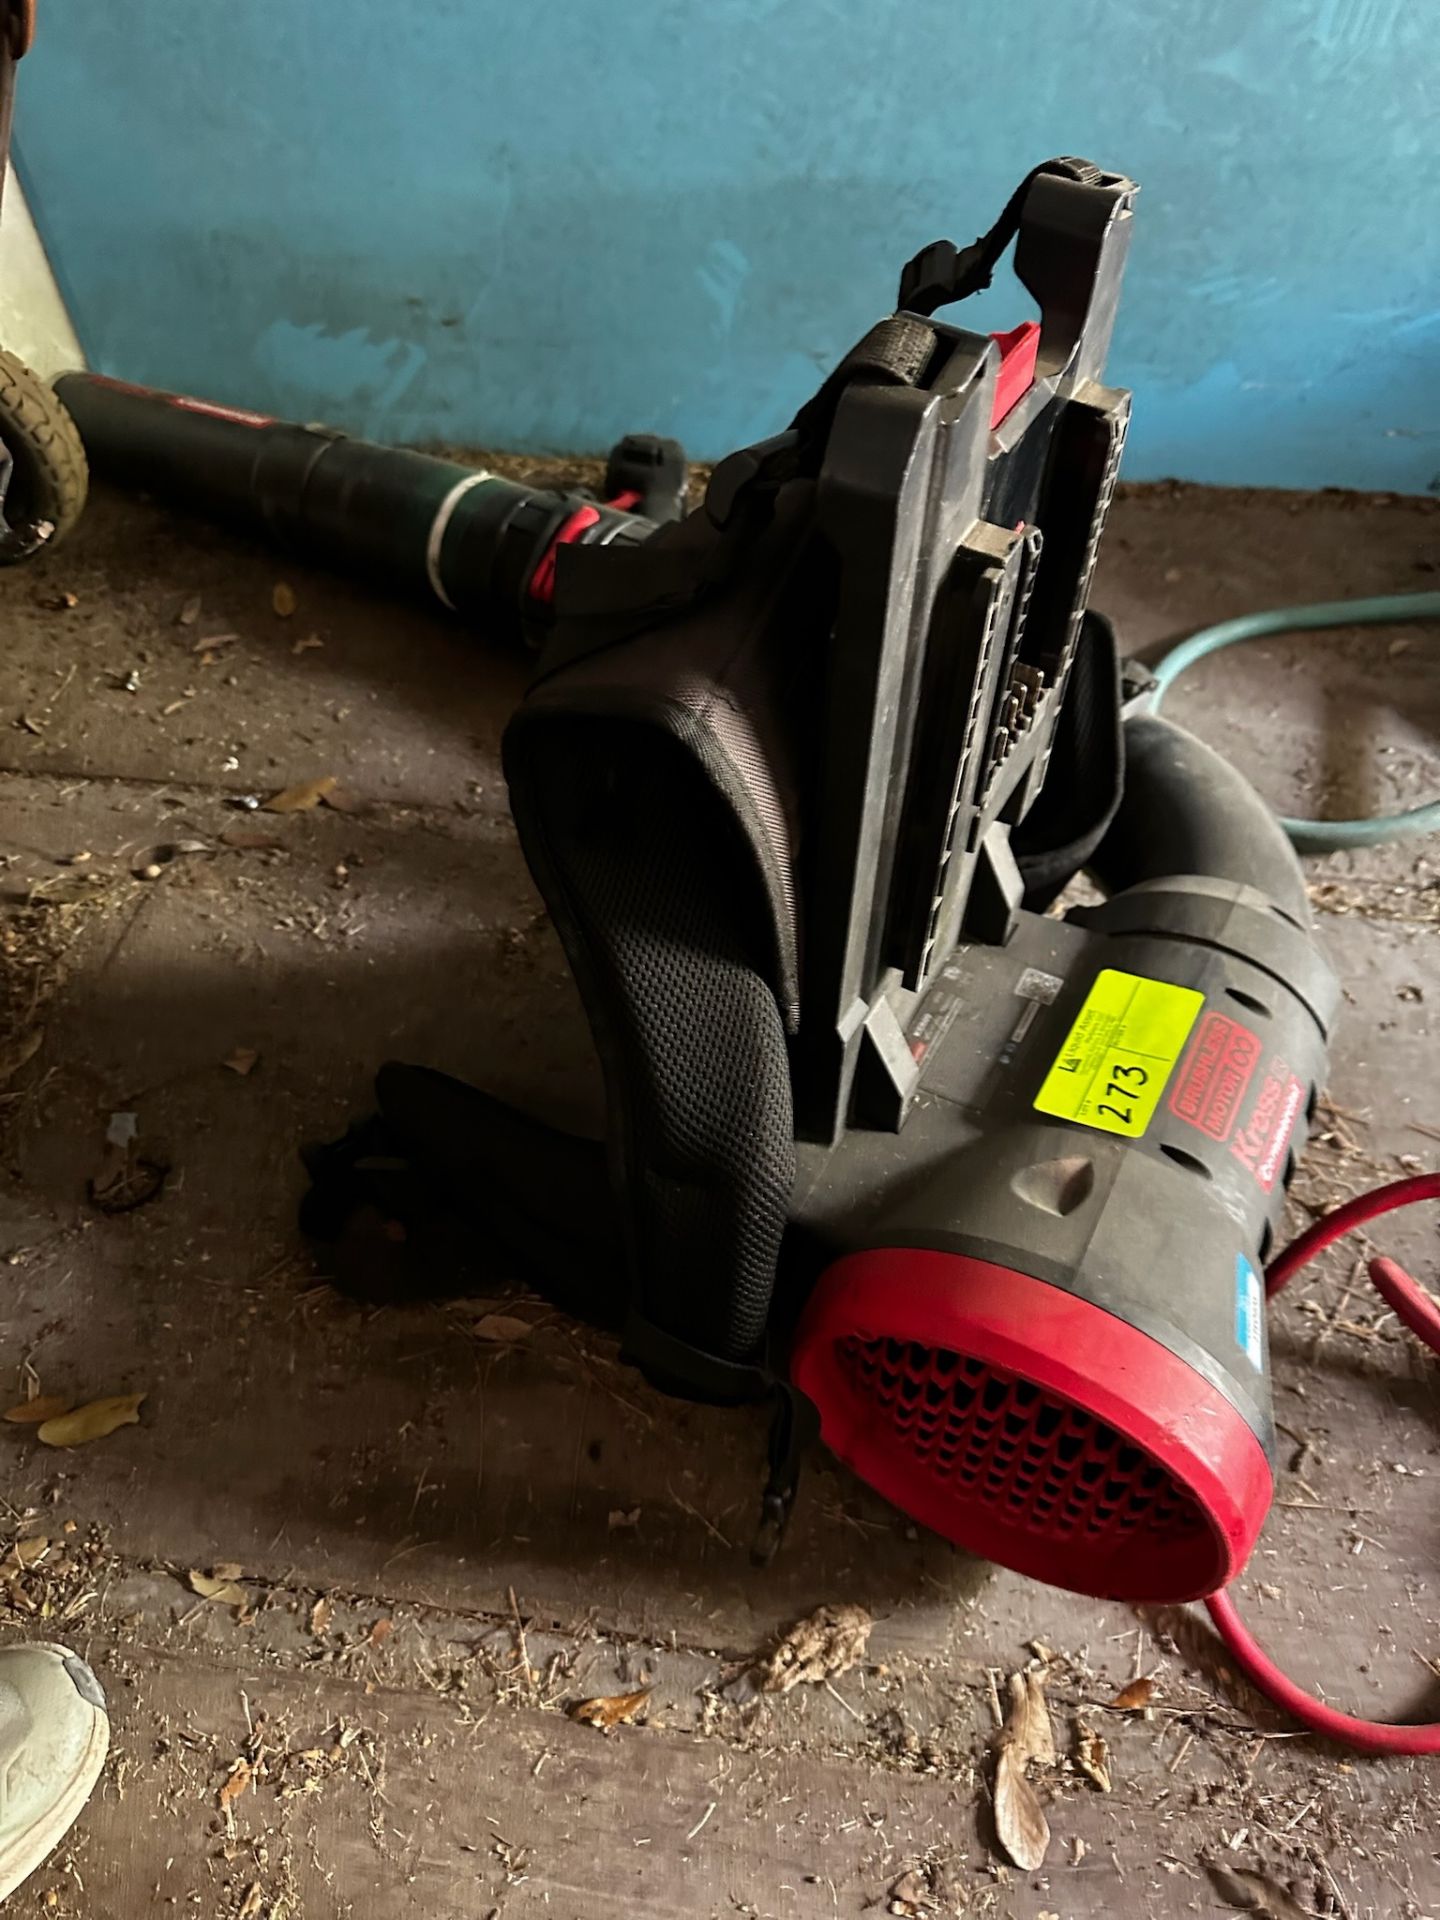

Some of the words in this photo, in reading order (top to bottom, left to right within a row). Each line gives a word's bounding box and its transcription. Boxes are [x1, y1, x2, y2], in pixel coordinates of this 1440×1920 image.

[1065, 1032, 1085, 1058] Liquid
[1180, 1020, 1229, 1114] BRUSHLESS
[1098, 1065, 1148, 1124] 273
[1206, 1069, 1241, 1133] MOTOR
[1229, 1074, 1282, 1173] Kress
